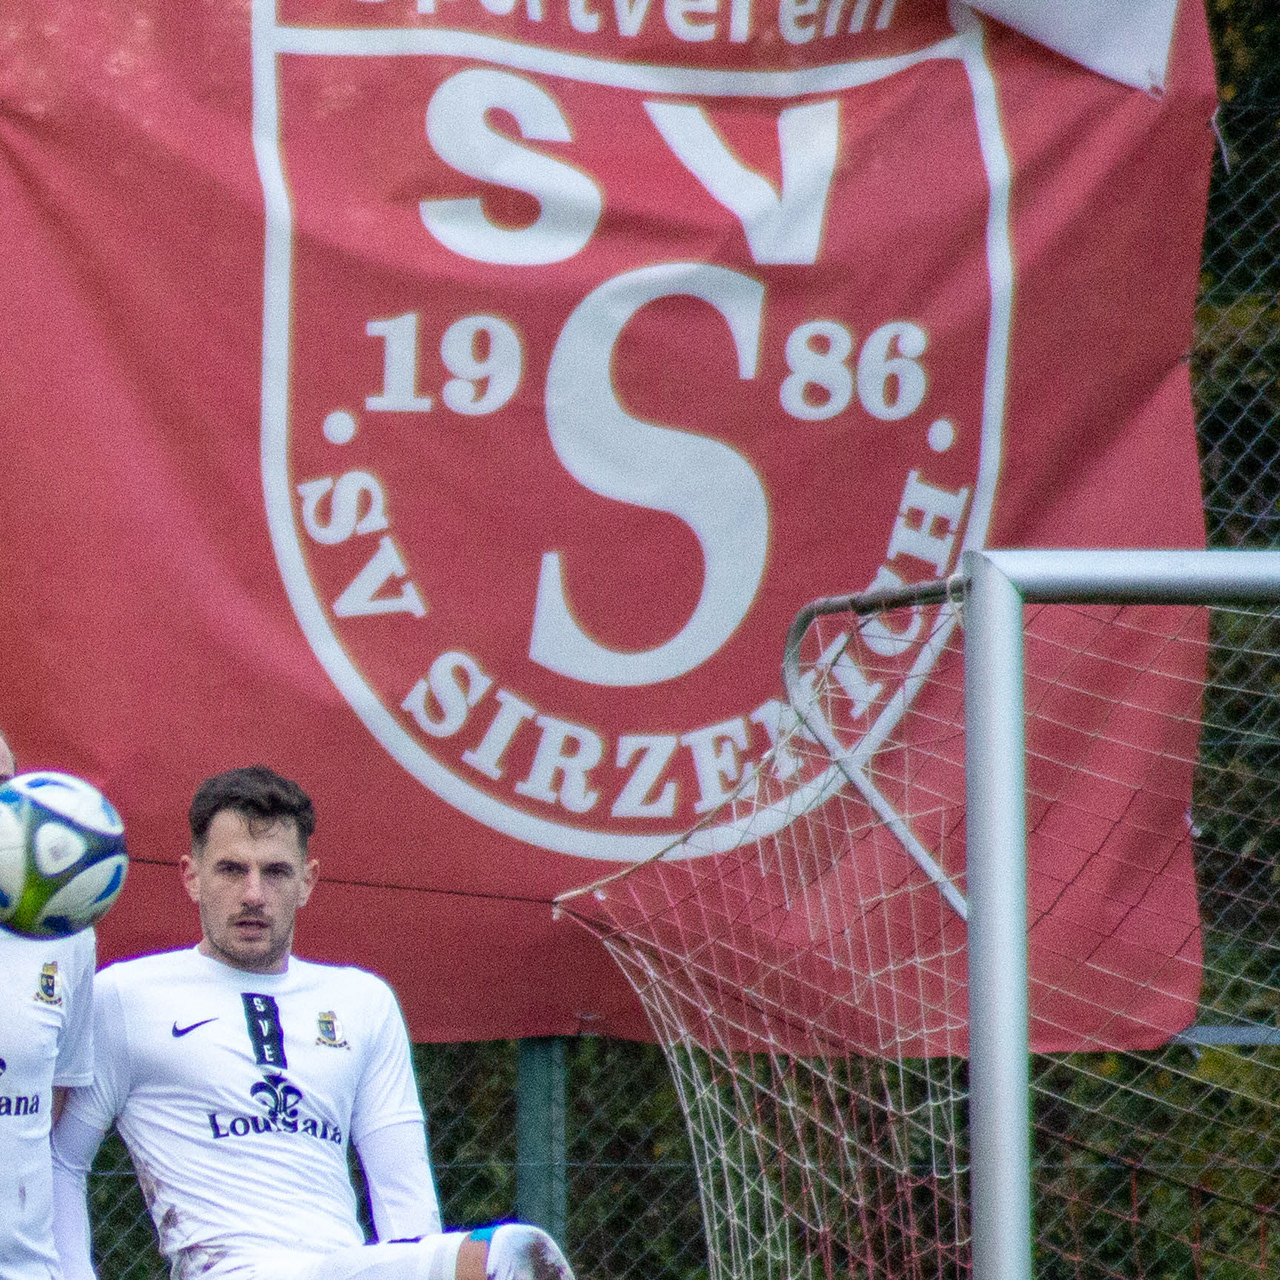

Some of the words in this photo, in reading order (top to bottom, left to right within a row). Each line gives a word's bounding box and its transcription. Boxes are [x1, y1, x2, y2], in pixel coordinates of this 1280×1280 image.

[418, 67, 840, 266] SV
[364, 312, 522, 415] 19
[779, 319, 928, 421] 86
[529, 262, 771, 688] S
[297, 470, 427, 619] SV
[253, 997, 274, 1062] SVE
[207, 1112, 342, 1145] Lousaa
